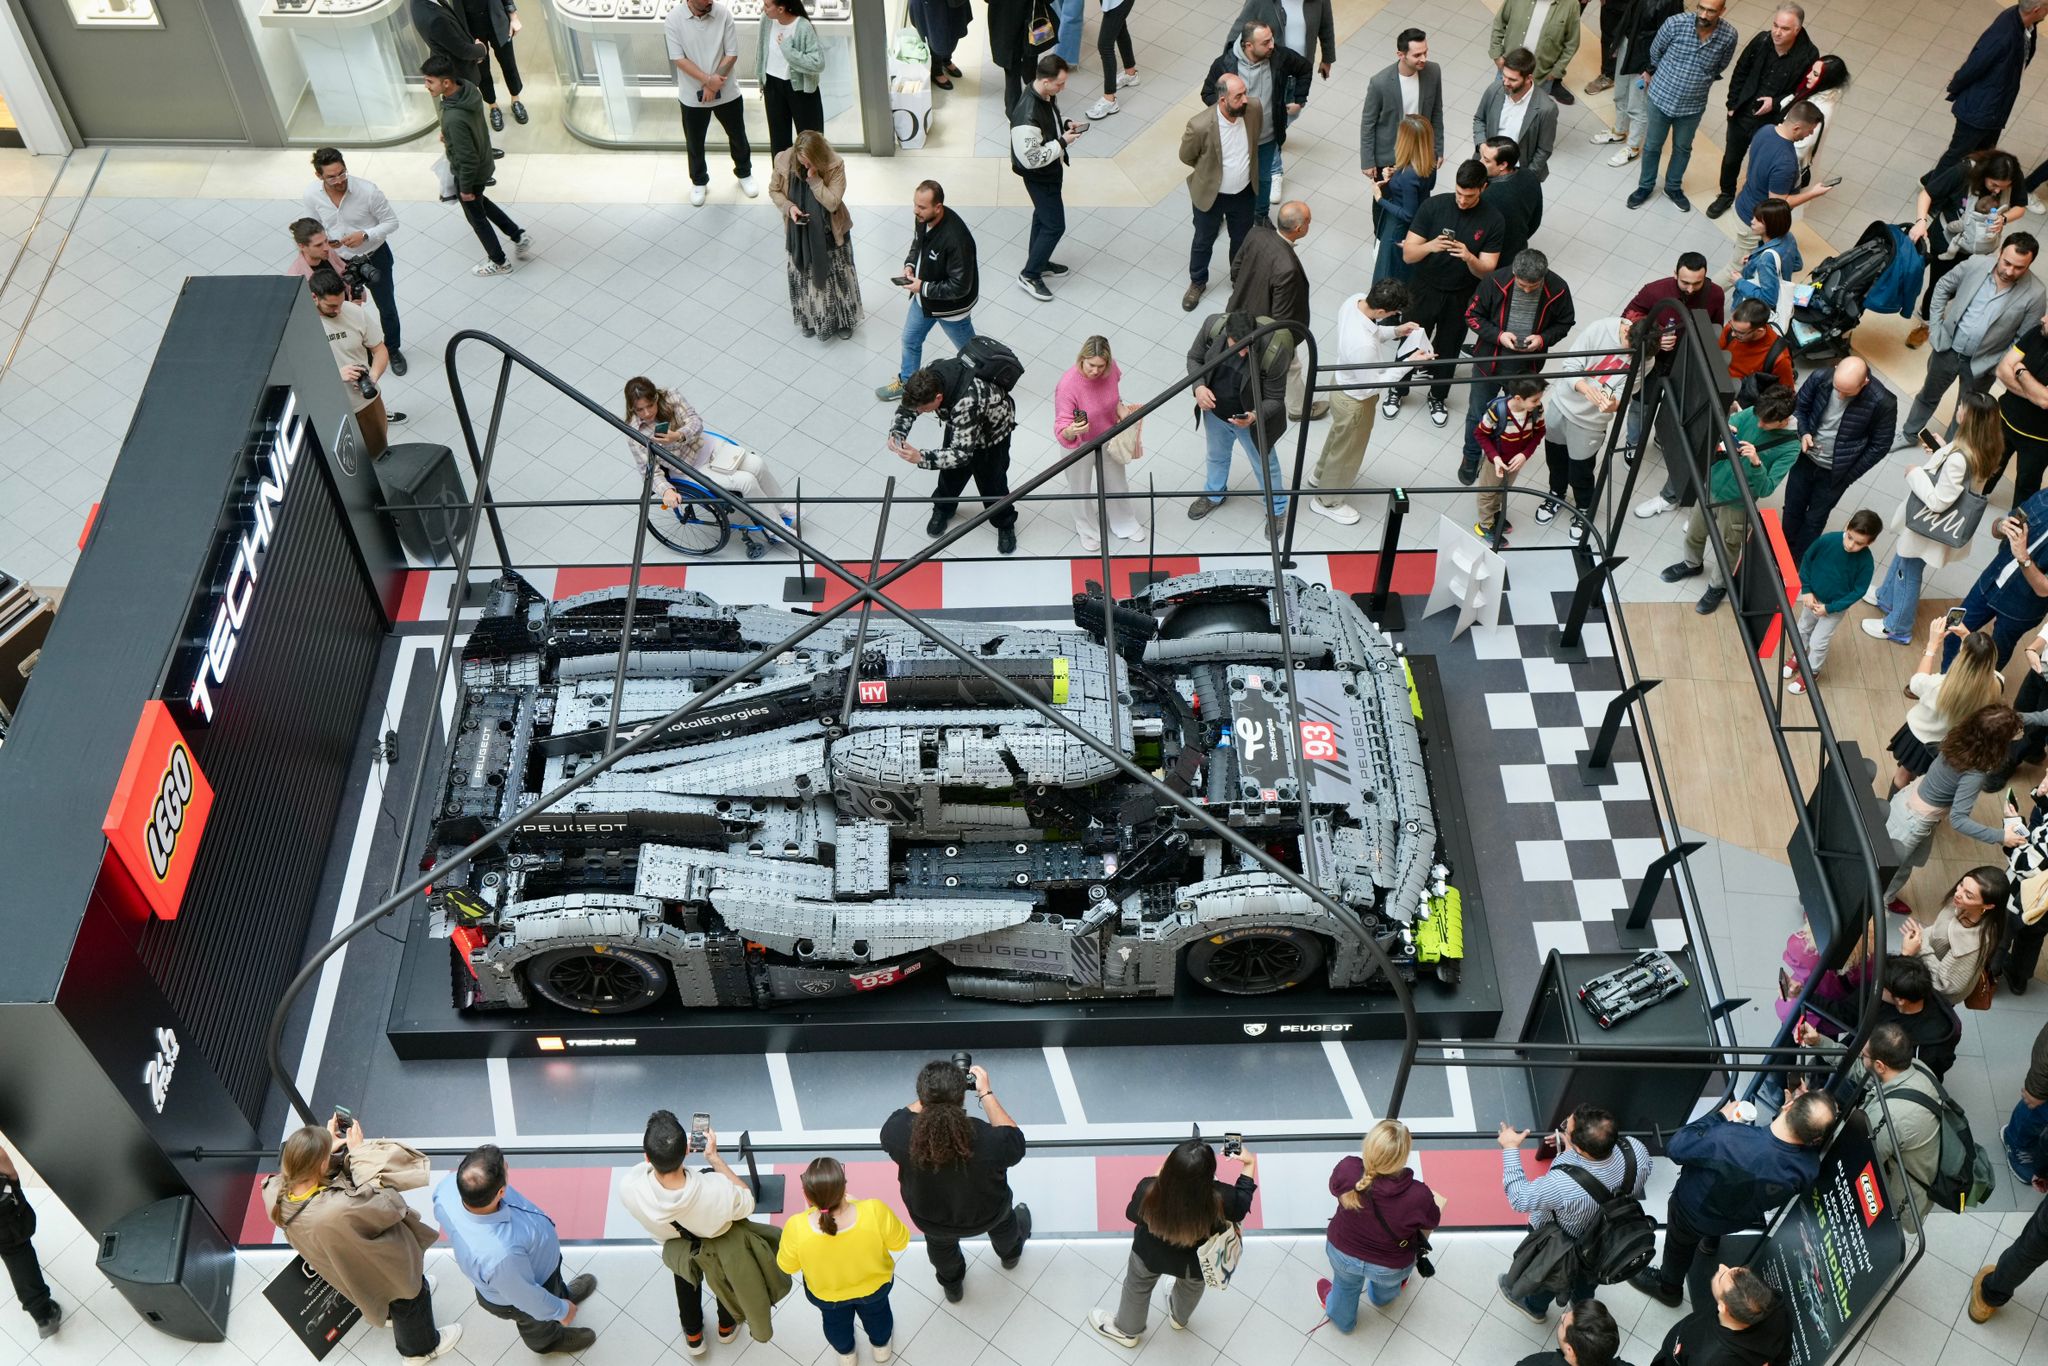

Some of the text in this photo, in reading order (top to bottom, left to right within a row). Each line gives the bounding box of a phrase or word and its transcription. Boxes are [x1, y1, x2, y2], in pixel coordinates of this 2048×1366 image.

[190, 391, 303, 722] TECHNIC
[861, 686, 884, 700] HY
[474, 727, 491, 778] PEUGEOT
[1266, 718, 1279, 762] TotalEnergies
[1303, 725, 1334, 757] 93
[1351, 706, 1369, 780] PEUGEOT
[146, 743, 193, 881] LEGO
[523, 824, 627, 832] PEUGEOT
[1231, 928, 1294, 938] MICHELIN
[615, 951, 661, 980] MICHELIN
[942, 944, 1064, 961] PEUGEOT
[861, 973, 894, 988] 93
[566, 1039, 637, 1047] TECHNIC
[1280, 1024, 1353, 1033] PEUGEOT
[1861, 1174, 1878, 1215] LEGO
[1829, 1190, 1841, 1223] LEGO
[1842, 1235, 1857, 1277] STORE
[1835, 1175, 1865, 1271] EVİNİZE TAŞIYIN
[1837, 1159, 1874, 1273] BU EŞSİZ DENEYİMİ
[1812, 1187, 1852, 1320] %15 İNDİRİM
[1841, 1257, 1852, 1290] ÖZEL
